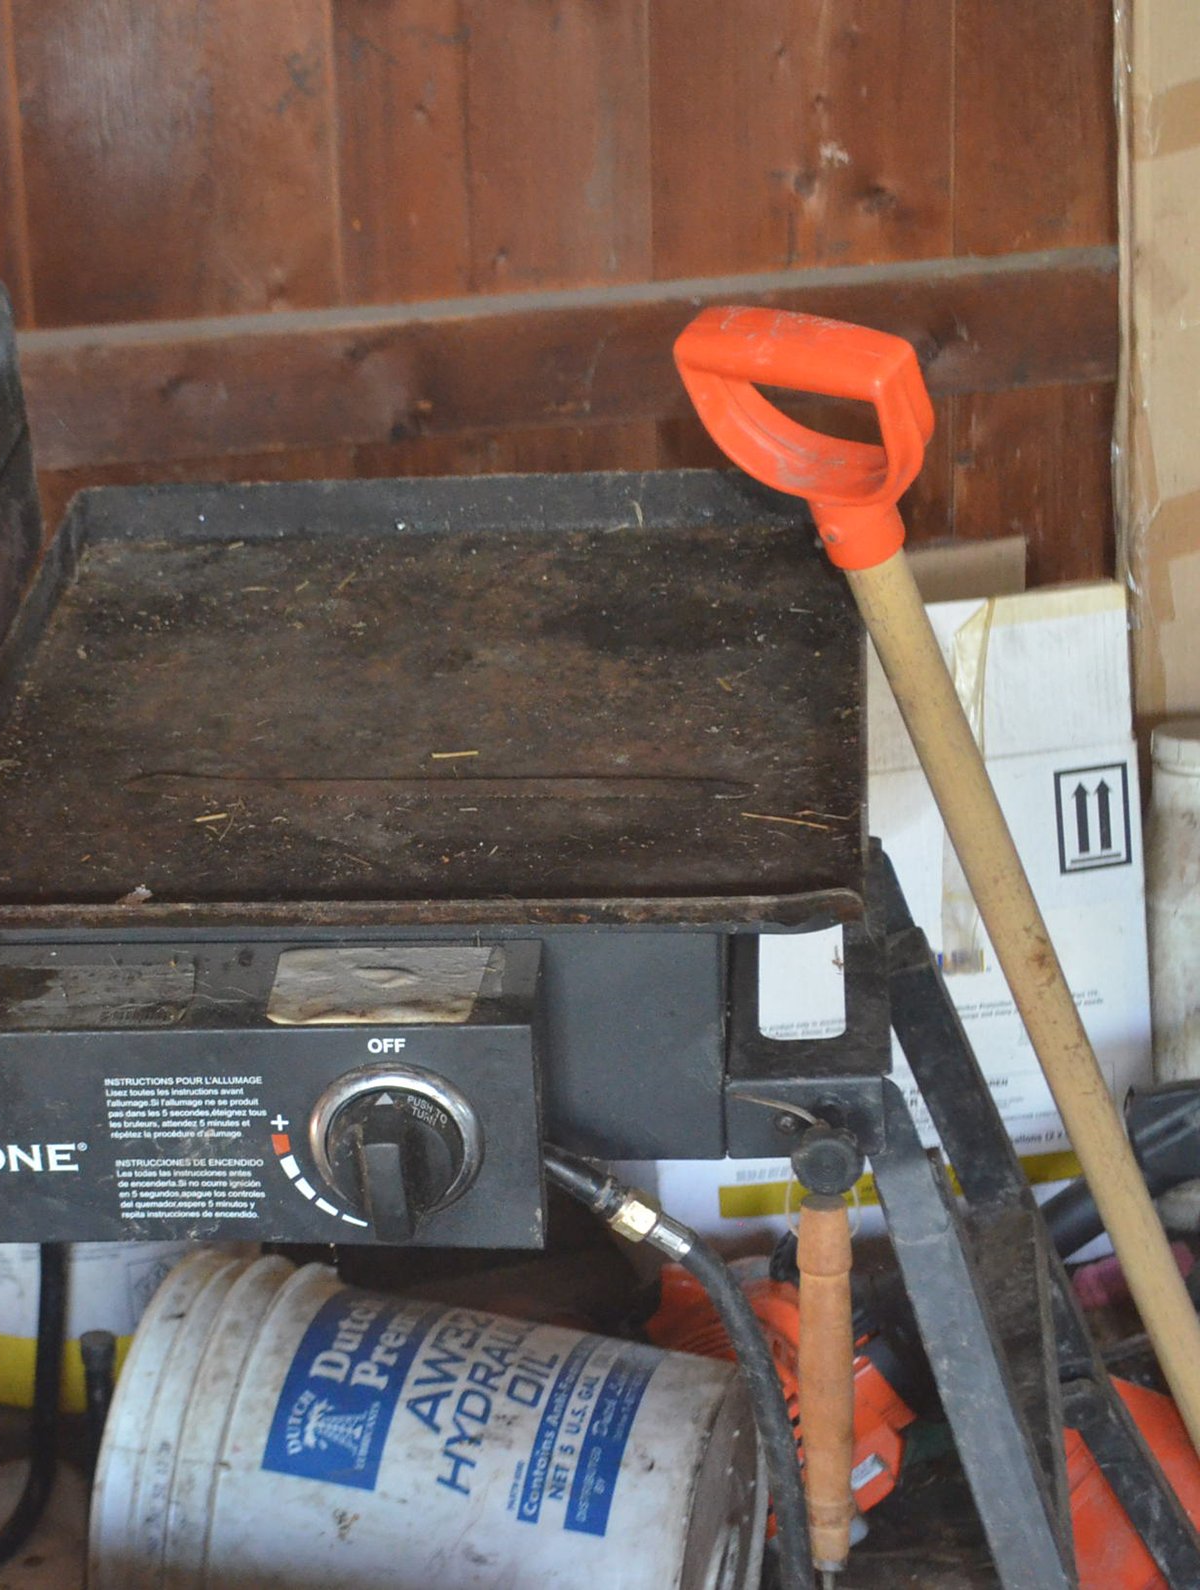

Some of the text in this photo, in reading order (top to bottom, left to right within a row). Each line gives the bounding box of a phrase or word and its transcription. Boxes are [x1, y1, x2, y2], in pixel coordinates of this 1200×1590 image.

[367, 1038, 406, 1053] OFF
[104, 1075, 263, 1087] INSTRUCTIONS POUR L'ALLUMAGE
[105, 1087, 244, 1097] Lisez toutes les instructions avant
[217, 1098, 228, 1106] se
[229, 1097, 259, 1107] produit
[108, 1109, 124, 1119] pas
[125, 1109, 146, 1118] dans
[147, 1108, 160, 1118] les
[248, 1108, 268, 1117] tous
[407, 1095, 448, 1125] PUSH TO
[411, 1105, 437, 1126] TURN
[109, 1120, 122, 1129] les
[161, 1119, 198, 1128] attendez
[206, 1118, 240, 1127] minutes
[241, 1119, 251, 1127] et
[1014, 1133, 1043, 1144] allons
[115, 1158, 264, 1168] INSTRUCCIONES DE ENCENDIDO
[116, 1168, 252, 1178] Lea todas las instrucciones antes
[117, 1180, 129, 1188] de
[188, 1180, 200, 1188] no
[201, 1180, 228, 1188] ocurre
[213, 1189, 227, 1198] los
[227, 1189, 266, 1199] controles
[215, 1199, 249, 1209] minutos
[249, 1200, 256, 1210] y
[146, 1210, 200, 1219] instrucciones
[201, 1209, 213, 1218] de
[309, 1300, 377, 1384] Dutc
[350, 1304, 422, 1391] Prem
[506, 1354, 560, 1409] OIL
[286, 1389, 316, 1455] DUTCH
[566, 1403, 589, 1435] U.S.
[560, 1443, 576, 1456] 5
[523, 1429, 556, 1517] Contains
[548, 1463, 571, 1500] NET
